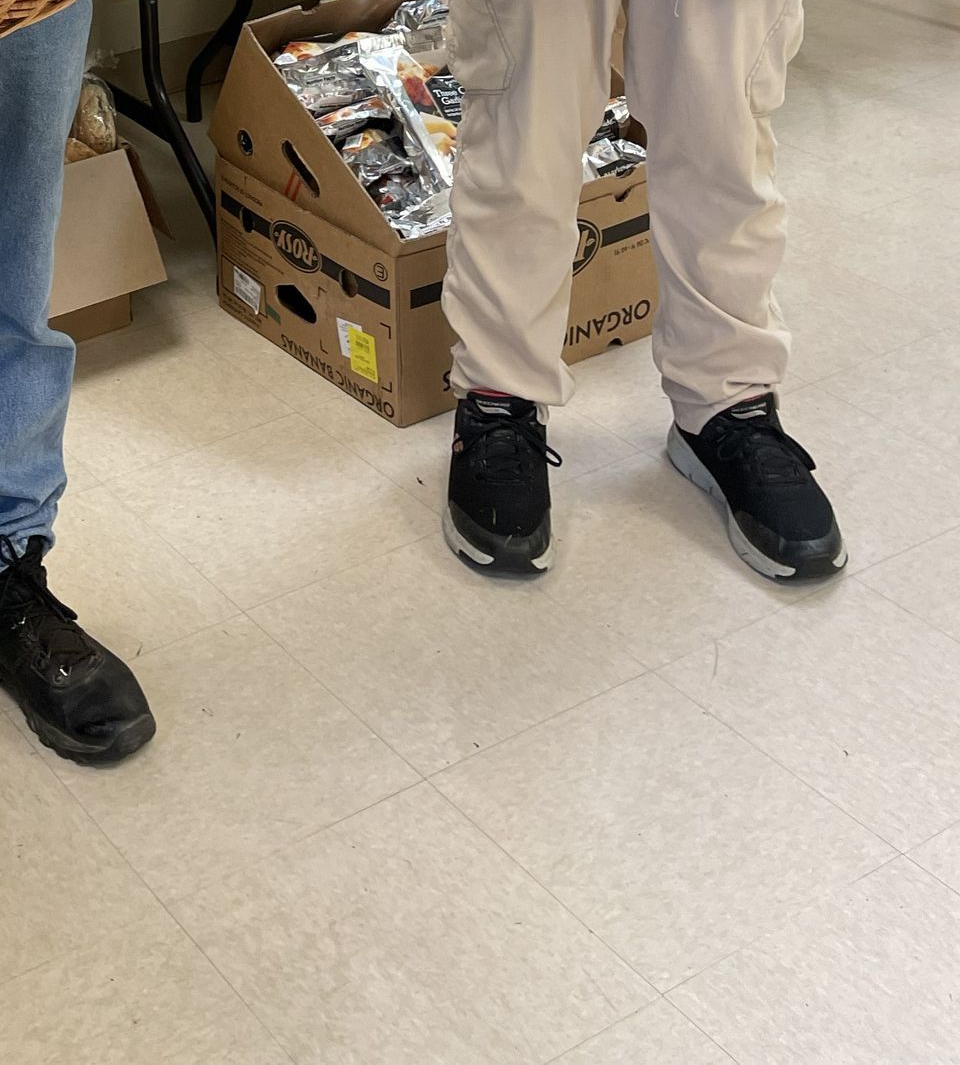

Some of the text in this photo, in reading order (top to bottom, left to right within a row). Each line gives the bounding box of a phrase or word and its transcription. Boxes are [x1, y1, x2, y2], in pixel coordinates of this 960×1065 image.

[276, 230, 314, 267] ROSY
[280, 333, 334, 380] BANANAS
[335, 370, 396, 419] ORGANIC
